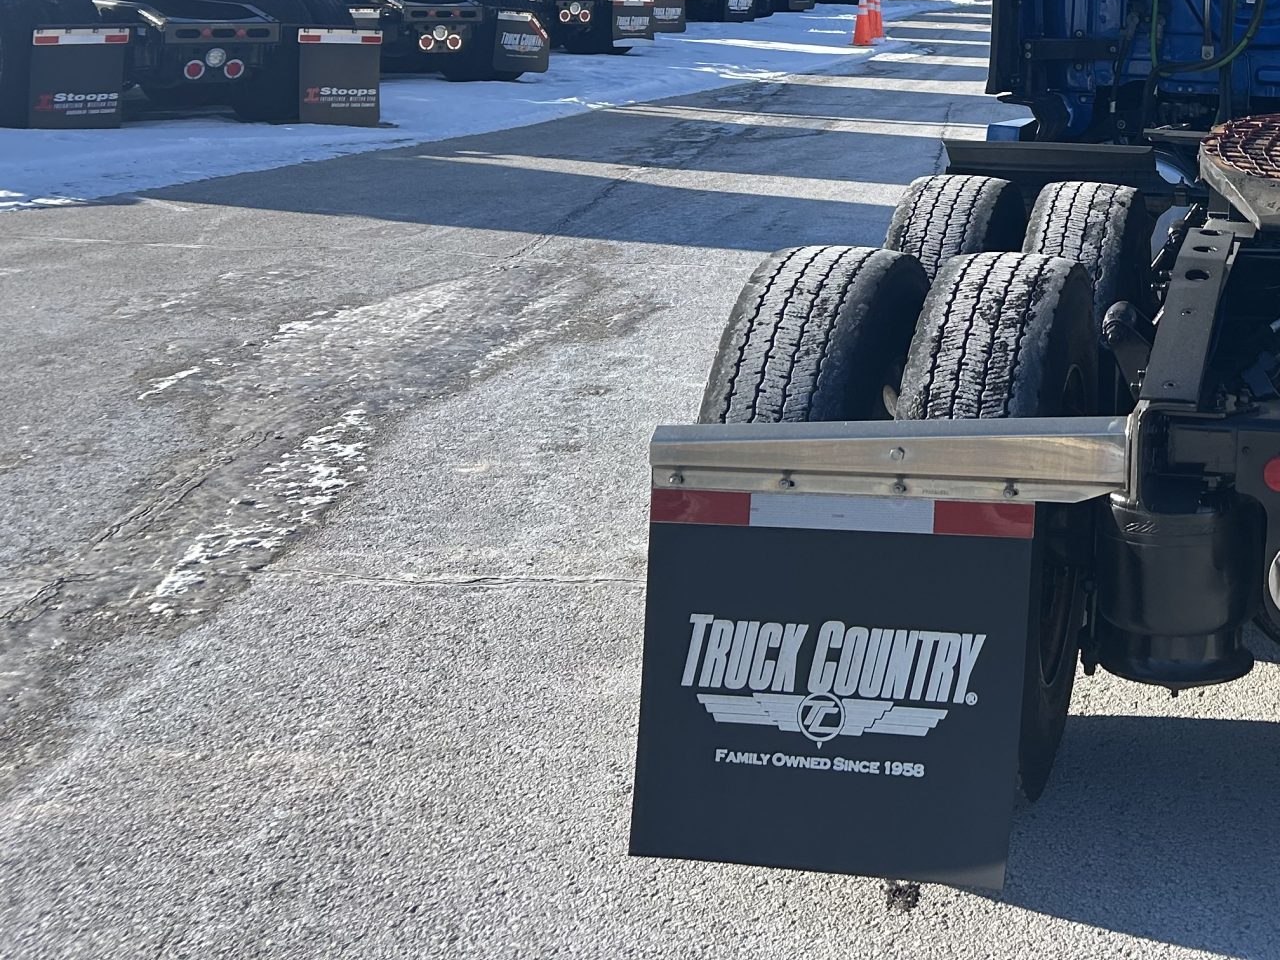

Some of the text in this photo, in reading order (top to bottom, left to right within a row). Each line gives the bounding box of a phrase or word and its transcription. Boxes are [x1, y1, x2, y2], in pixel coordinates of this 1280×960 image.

[53, 92, 119, 103] Stoops
[320, 87, 377, 97] Stoops
[680, 613, 810, 694] TRUCK
[715, 748, 925, 779] FAMILY OWNED SINCE 1958
